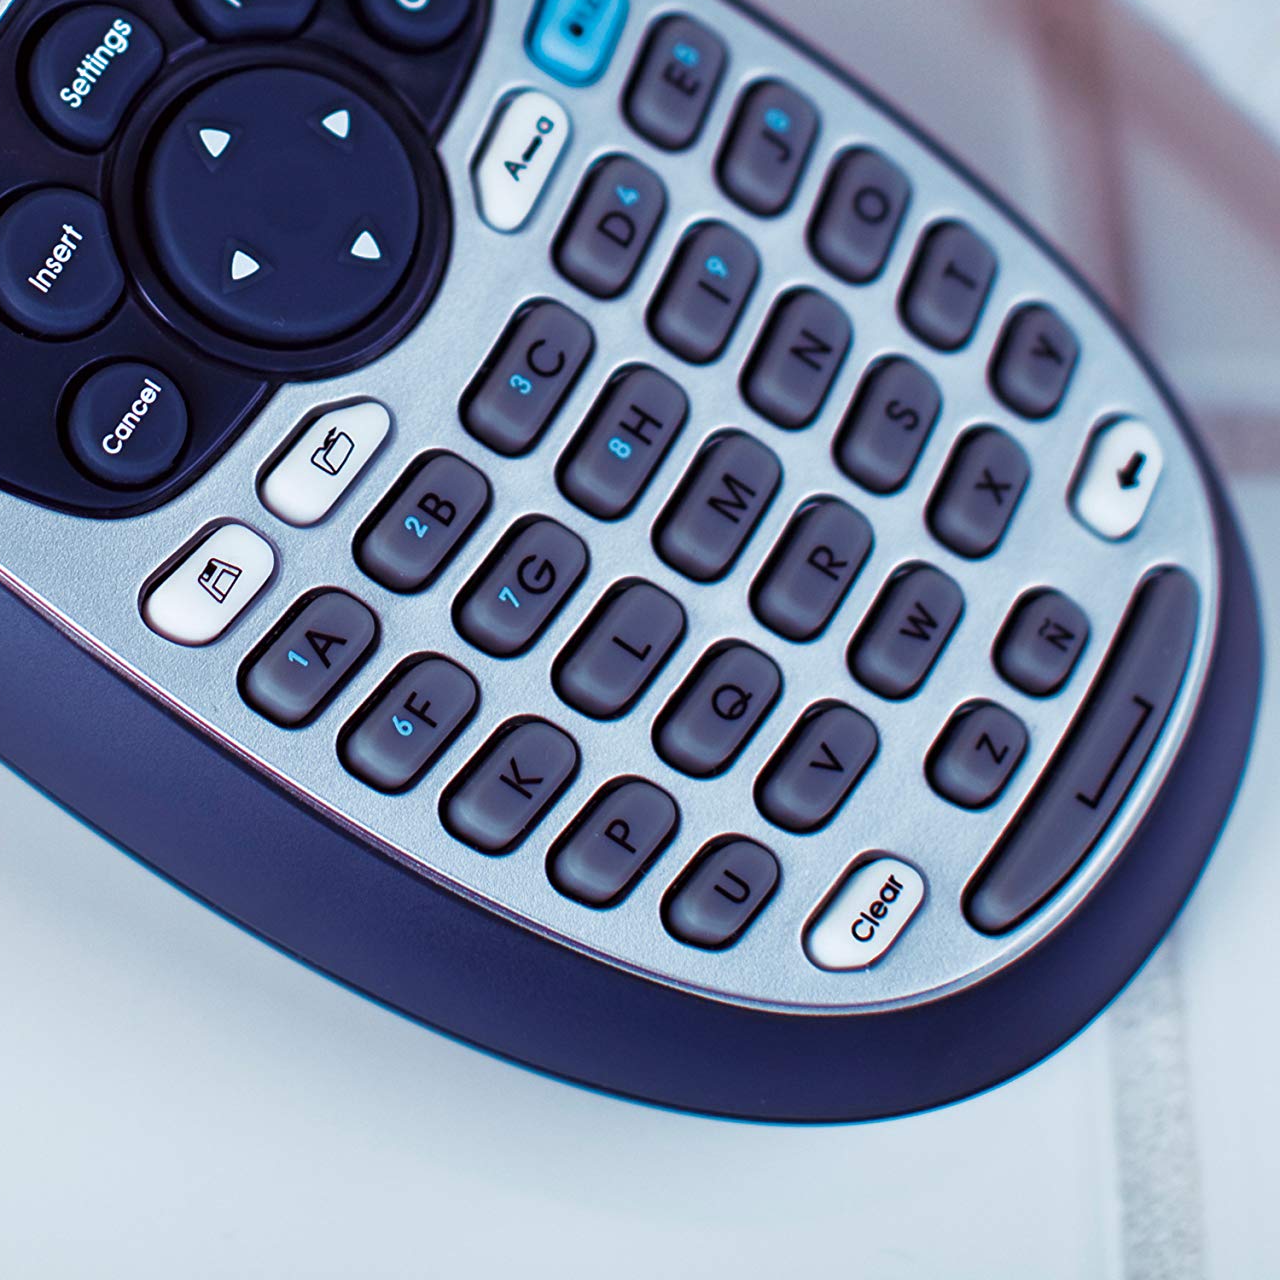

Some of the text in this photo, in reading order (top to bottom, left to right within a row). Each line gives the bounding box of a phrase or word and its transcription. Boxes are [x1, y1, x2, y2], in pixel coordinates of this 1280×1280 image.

[60, 19, 131, 108] Settings
[663, 61, 700, 97] E
[762, 129, 790, 163] J
[597, 185, 640, 248] D 4
[853, 186, 890, 223] O
[28, 224, 83, 293] Insert
[944, 261, 976, 292] T
[698, 256, 731, 304] I 9
[510, 338, 566, 395] 3 C
[790, 330, 832, 371] N
[1032, 334, 1064, 366] Y
[102, 378, 162, 455] Cancel
[608, 404, 663, 459] 8 H
[885, 400, 919, 431] S
[708, 472, 756, 524] M
[974, 467, 1012, 505] X
[405, 491, 457, 539] 2 B
[499, 554, 557, 609] 7 G
[807, 544, 848, 581] R
[899, 602, 939, 642] W
[1038, 617, 1076, 653] Ñ
[287, 629, 348, 669] 1 A
[612, 635, 653, 661] L
[392, 691, 438, 736] 6 F
[710, 683, 753, 720] Q
[809, 742, 845, 774] V
[976, 732, 1010, 765] Z
[499, 757, 544, 799] K
[604, 818, 637, 854] P
[713, 869, 751, 904] U
[851, 874, 904, 942] Clear
